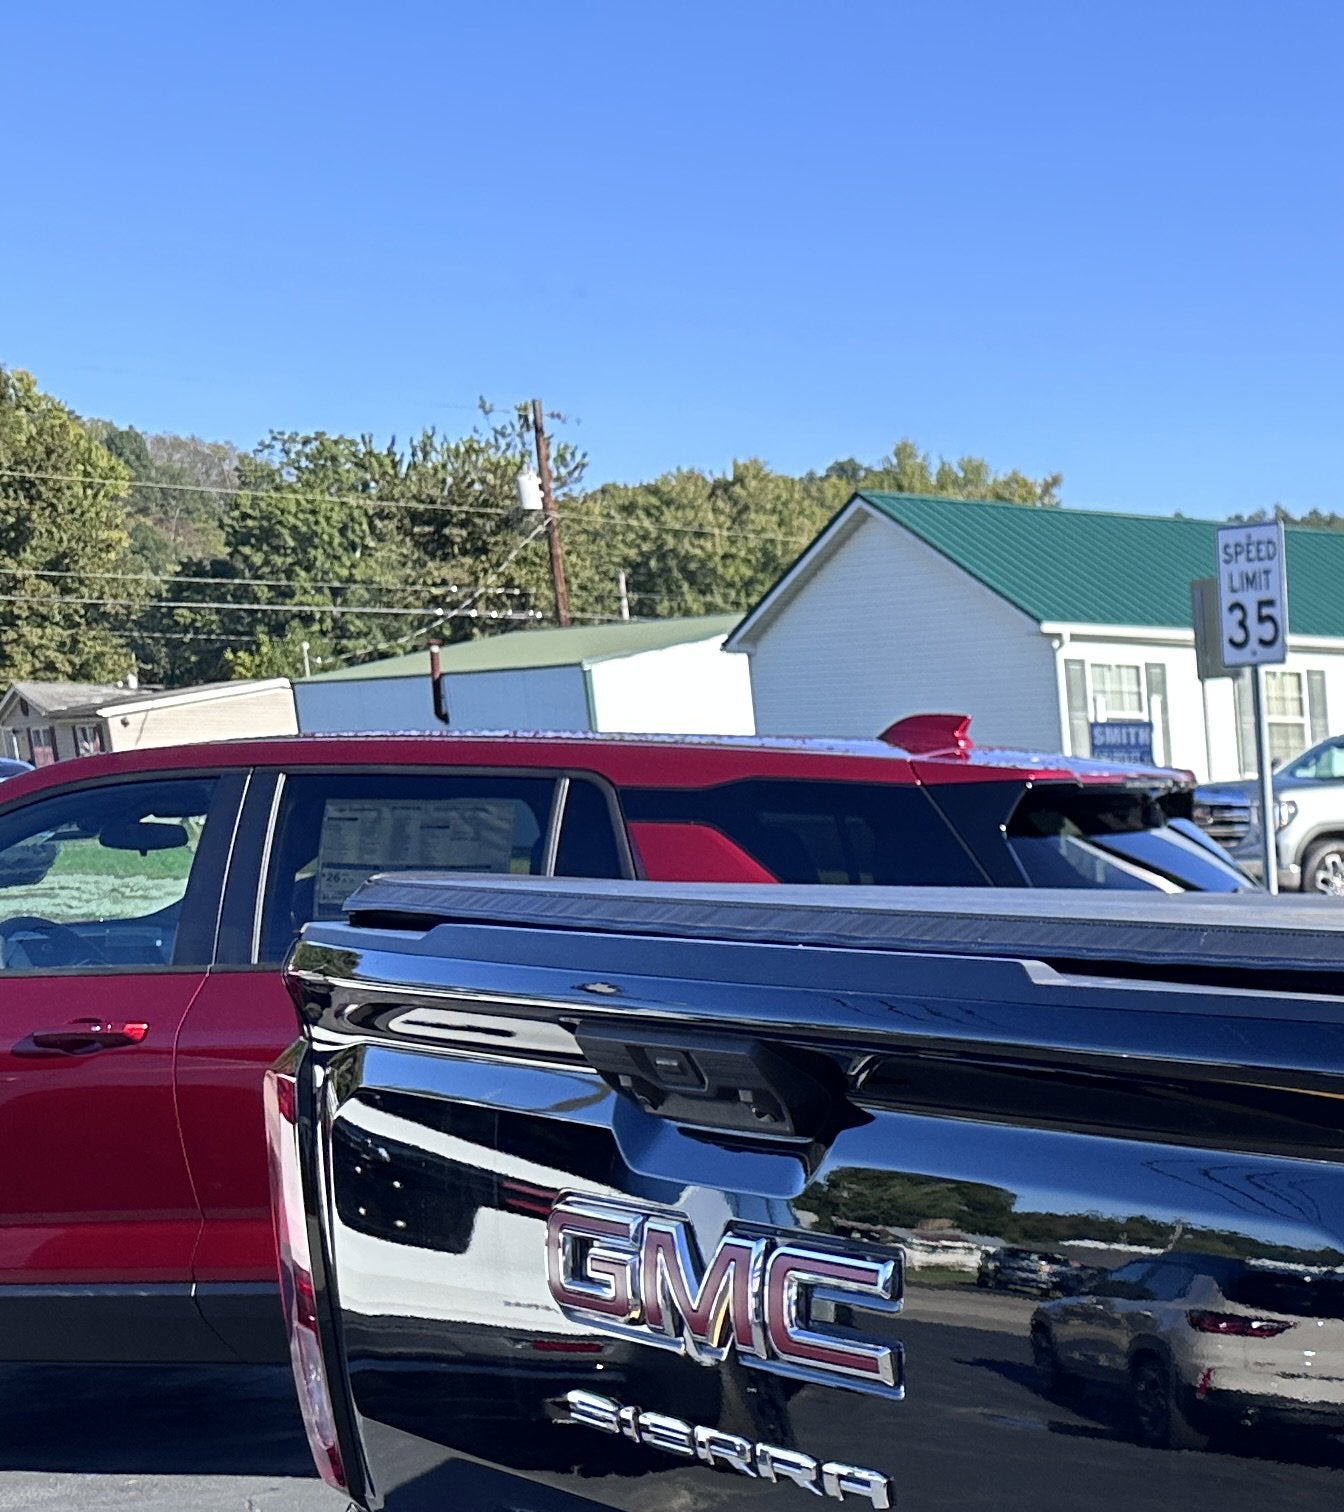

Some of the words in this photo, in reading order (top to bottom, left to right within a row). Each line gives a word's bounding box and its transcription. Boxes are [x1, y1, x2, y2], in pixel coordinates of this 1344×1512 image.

[1222, 539, 1277, 565] SPEED
[1228, 569, 1273, 594] LIMIT
[1226, 598, 1281, 651] 35
[1093, 725, 1151, 746] SMITH
[545, 1187, 907, 1400] GMC
[564, 1389, 895, 1511] SIERRA
